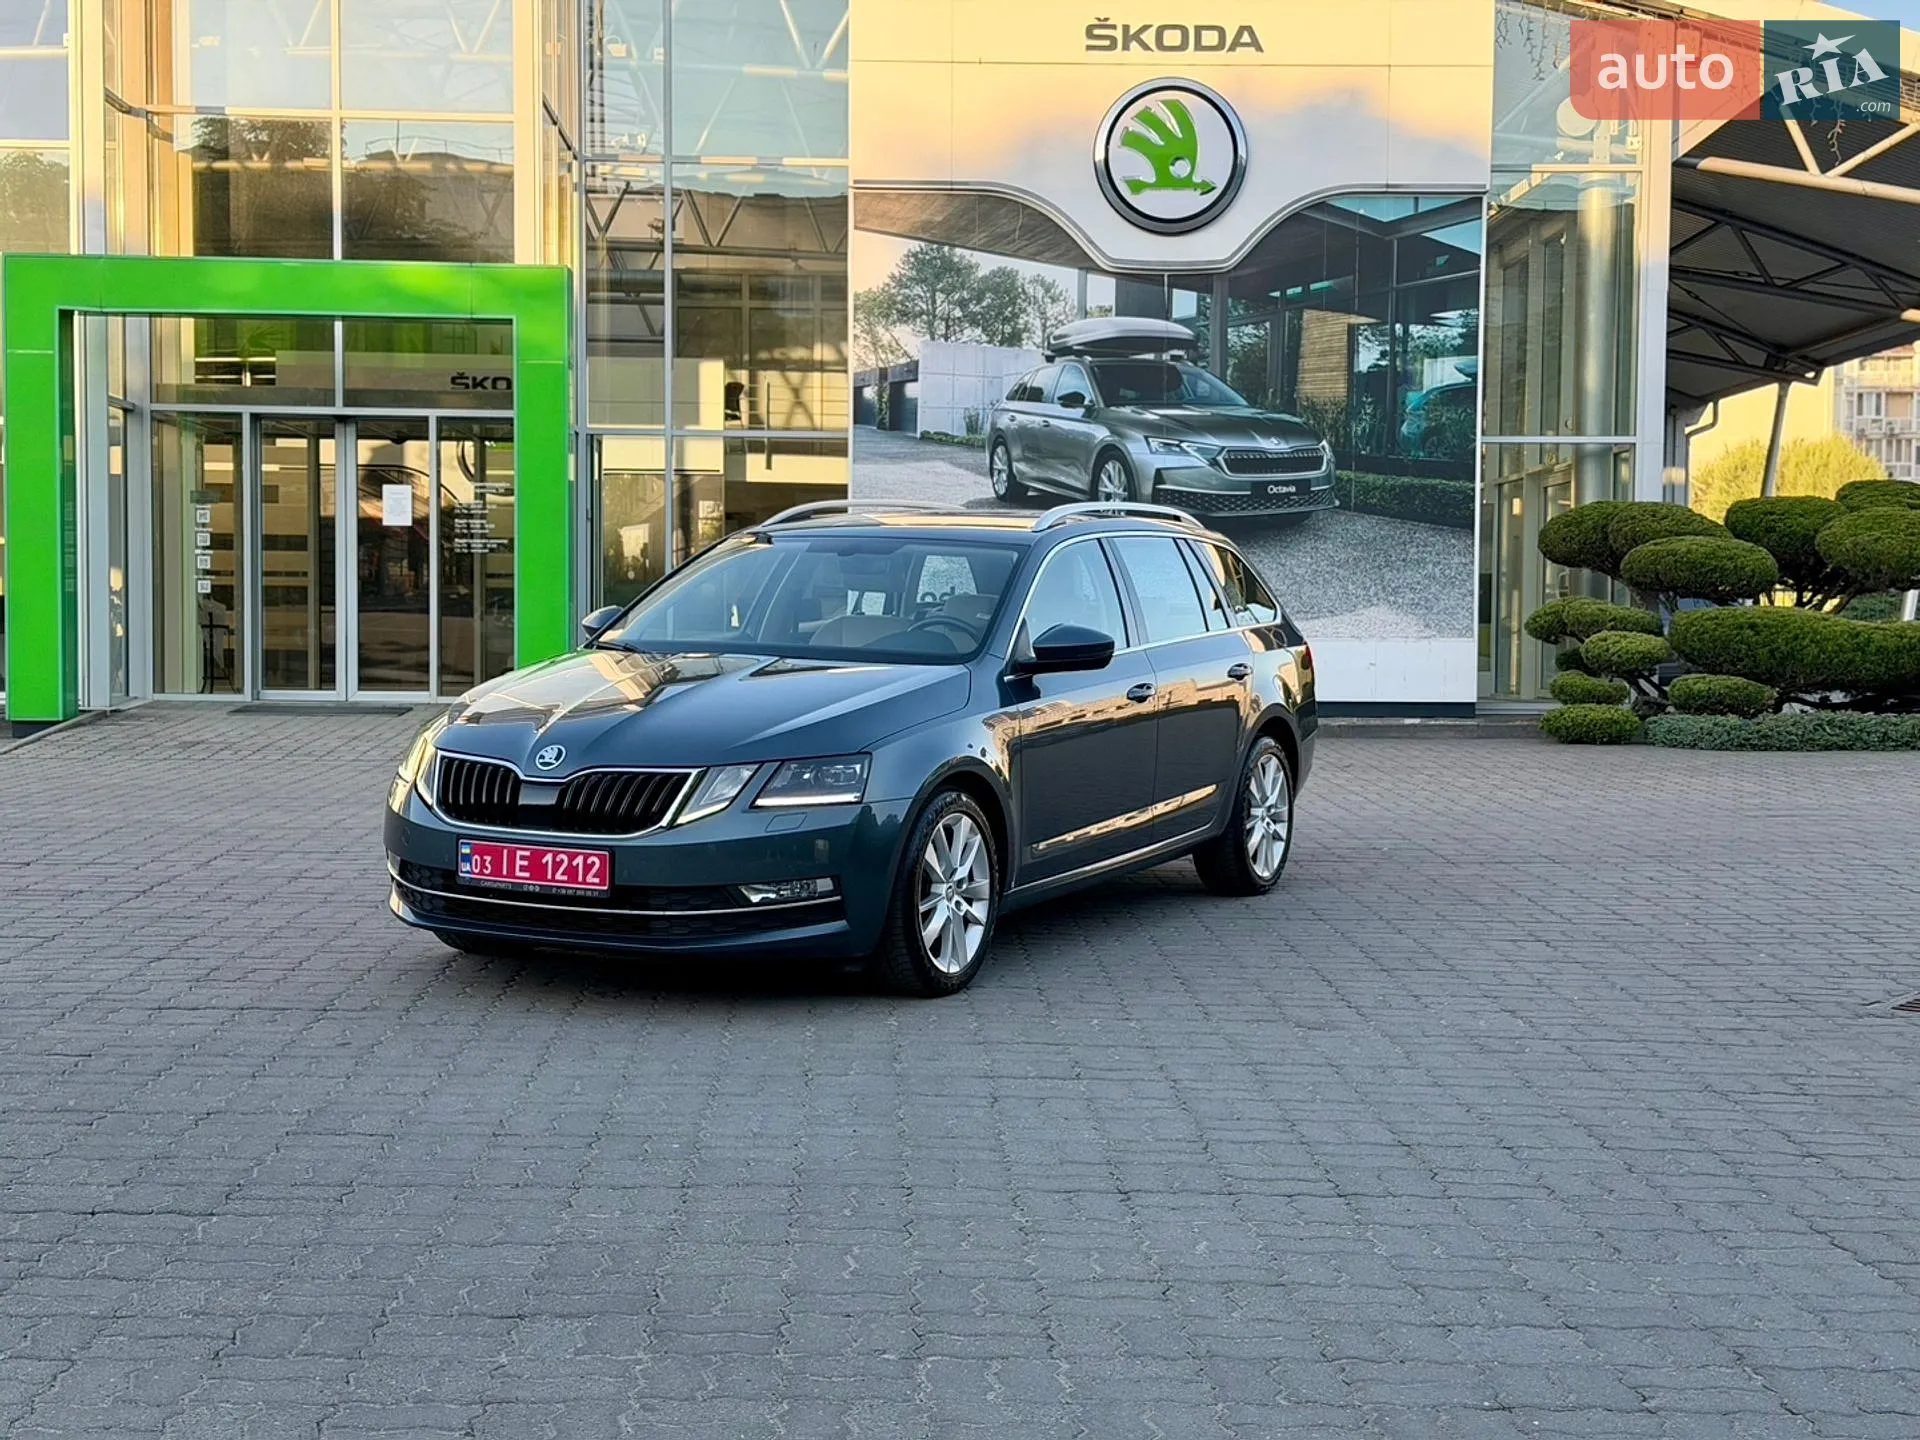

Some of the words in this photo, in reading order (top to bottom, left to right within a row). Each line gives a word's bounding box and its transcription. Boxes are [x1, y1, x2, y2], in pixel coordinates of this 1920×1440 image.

[1085, 17, 1264, 53] ŠKODA
[1267, 485, 1296, 494] Octavia
[461, 862, 471, 873] UA
[472, 855, 493, 874] 03
[502, 848, 531, 878] IE
[541, 852, 601, 884] 1212
